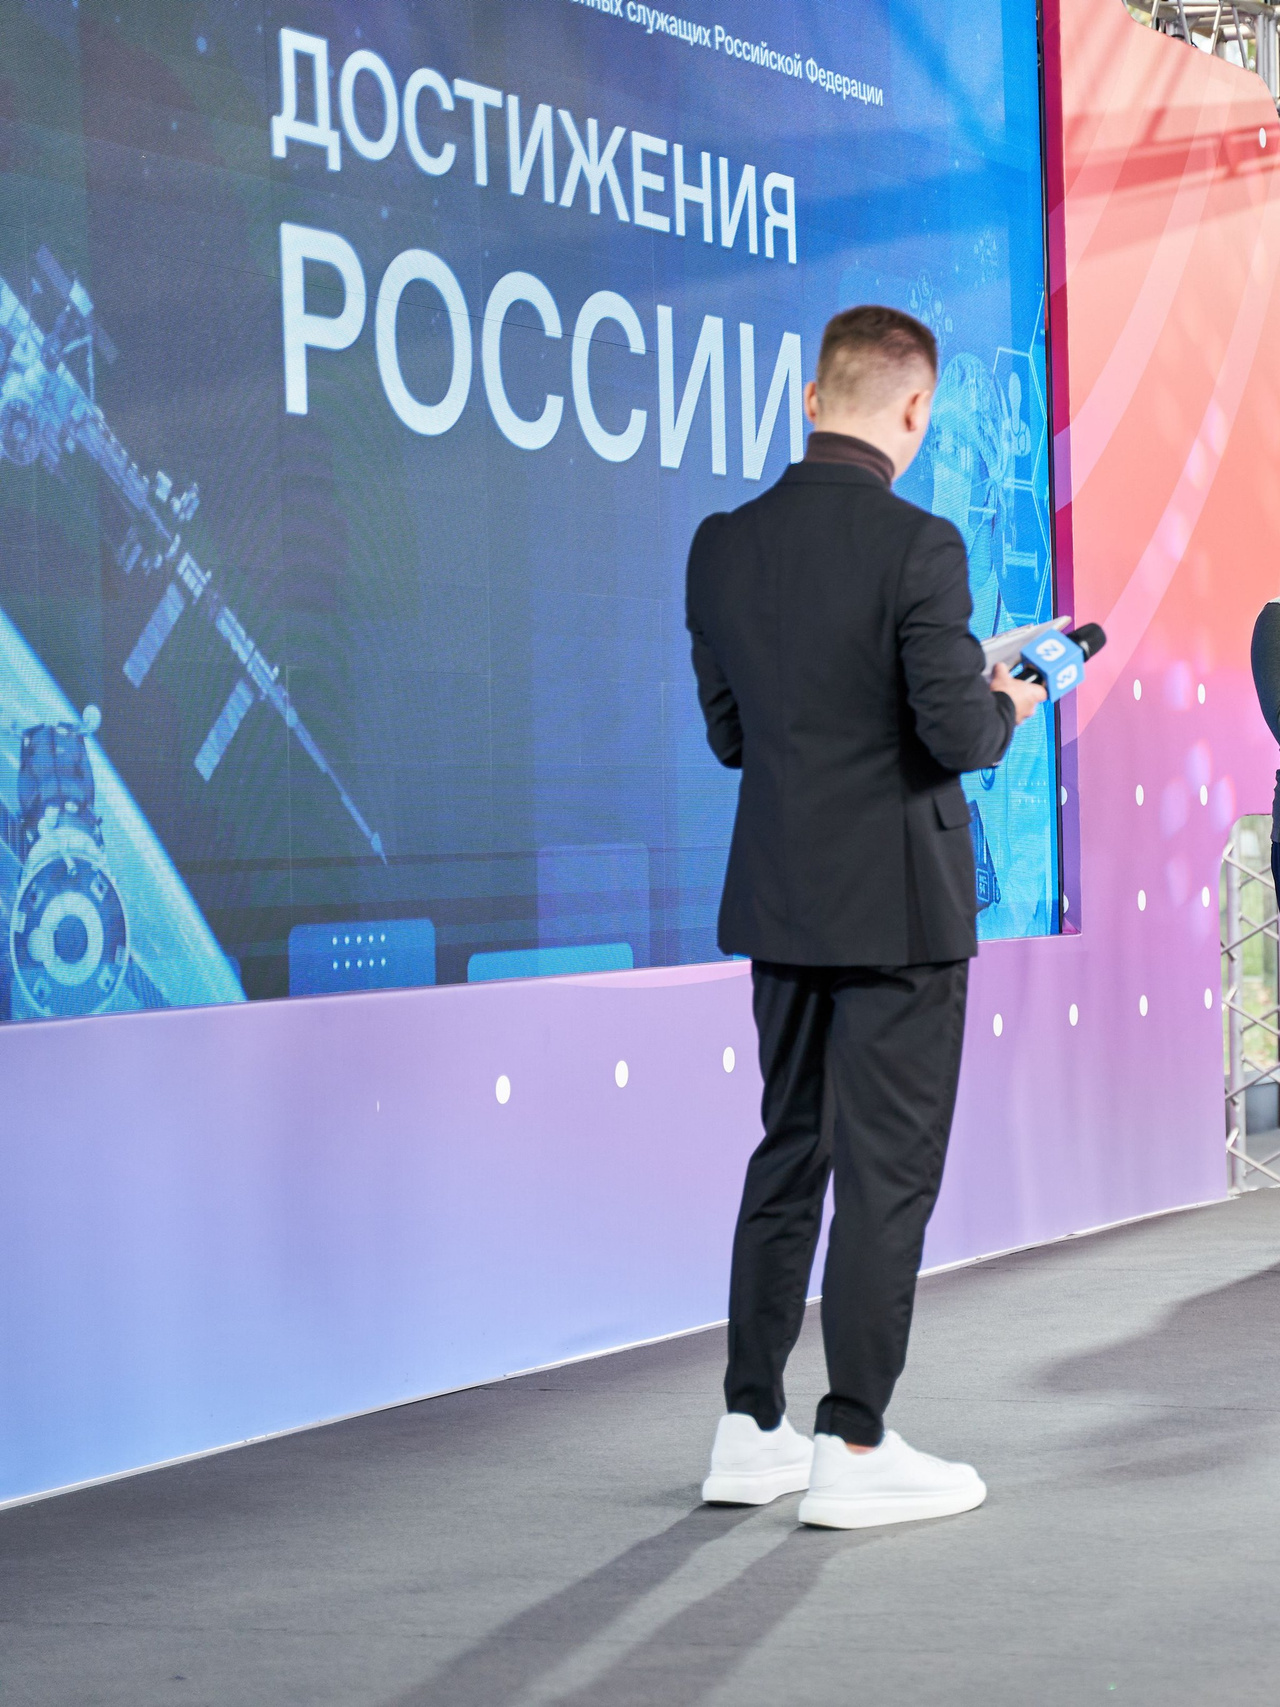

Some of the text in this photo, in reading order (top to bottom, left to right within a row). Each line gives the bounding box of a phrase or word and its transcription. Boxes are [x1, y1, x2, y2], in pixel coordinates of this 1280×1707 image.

[271, 27, 798, 265] ДОСТИЖЕНИЯ
[626, 0, 712, 47] служащих
[714, 24, 803, 79] Российской
[805, 57, 884, 107] Федерации
[280, 221, 805, 481] РОССИИ
